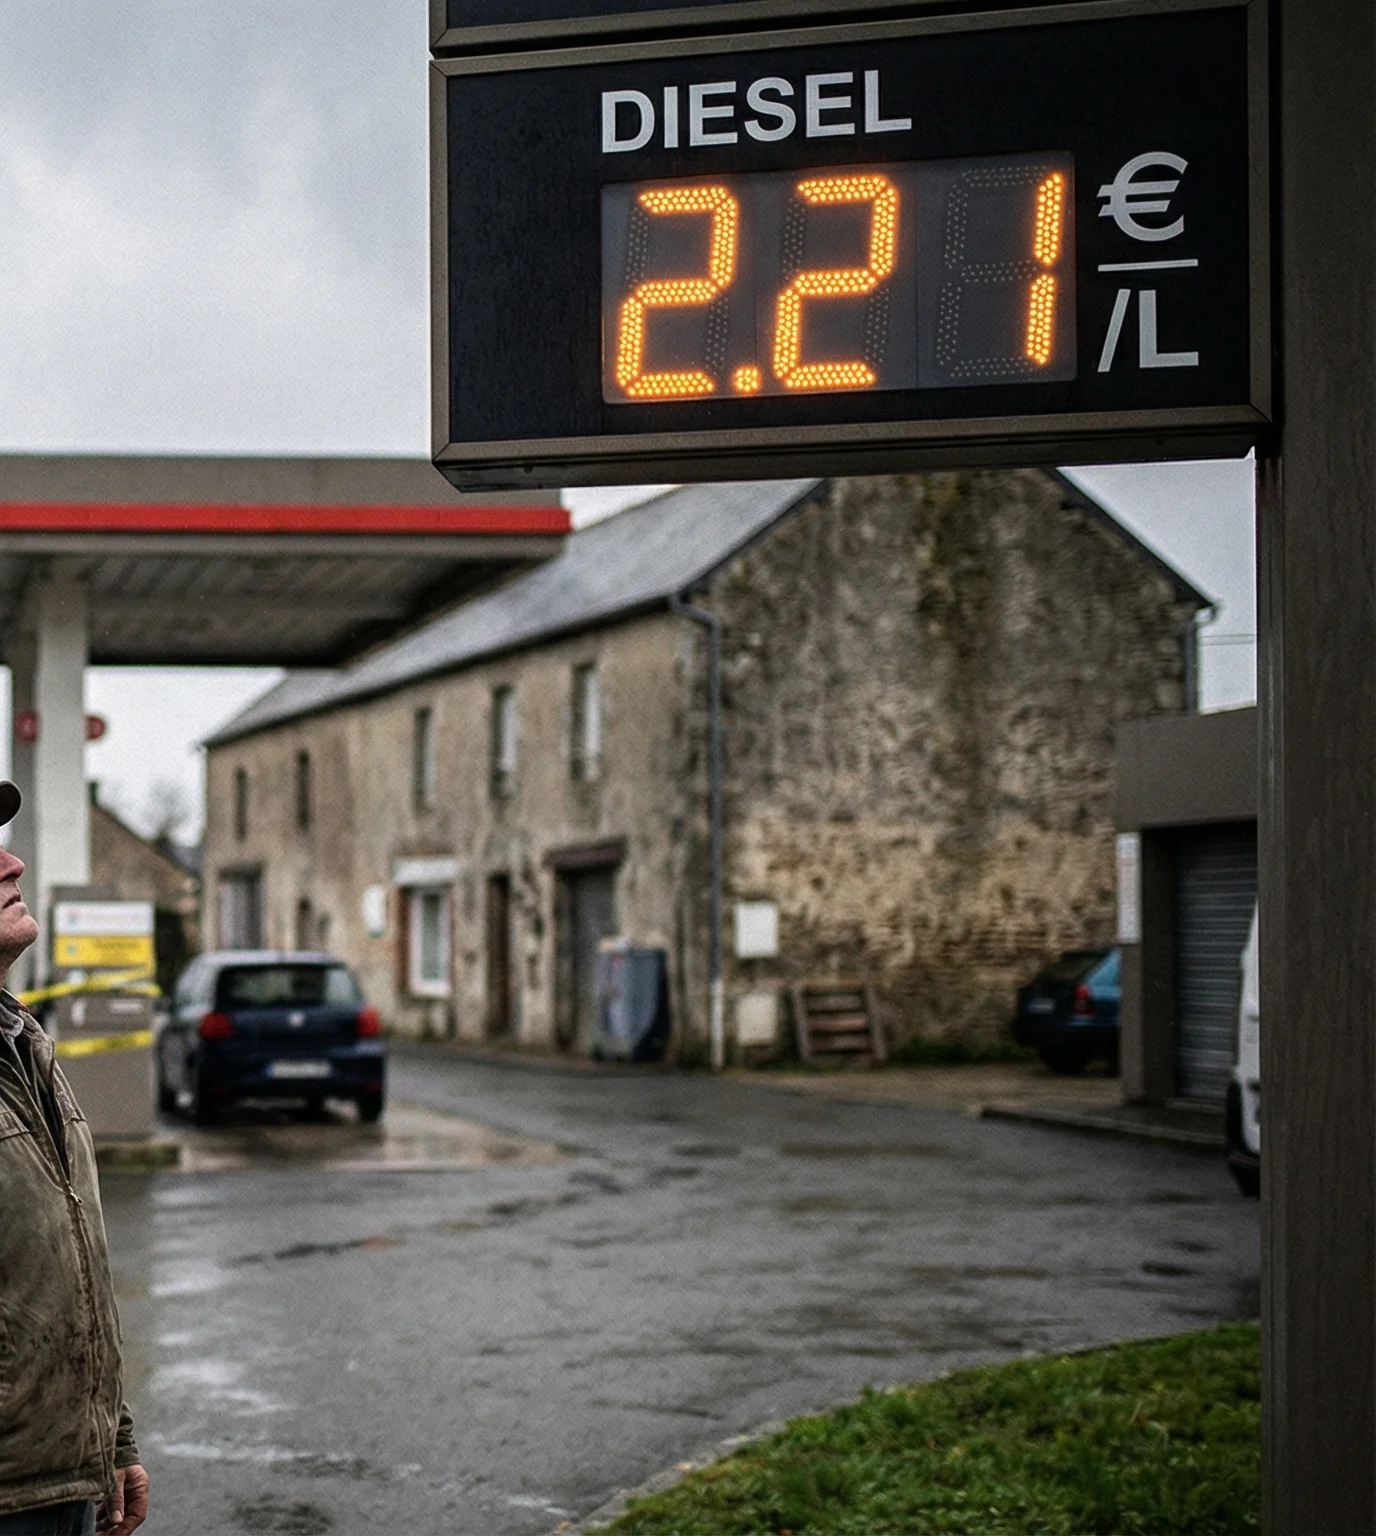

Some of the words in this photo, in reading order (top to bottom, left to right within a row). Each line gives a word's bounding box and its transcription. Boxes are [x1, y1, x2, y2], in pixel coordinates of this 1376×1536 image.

[601, 69, 912, 154] DIESEL
[1097, 151, 1189, 242] €
[616, 172, 1064, 398] 2.21
[1097, 288, 1199, 373] /L
